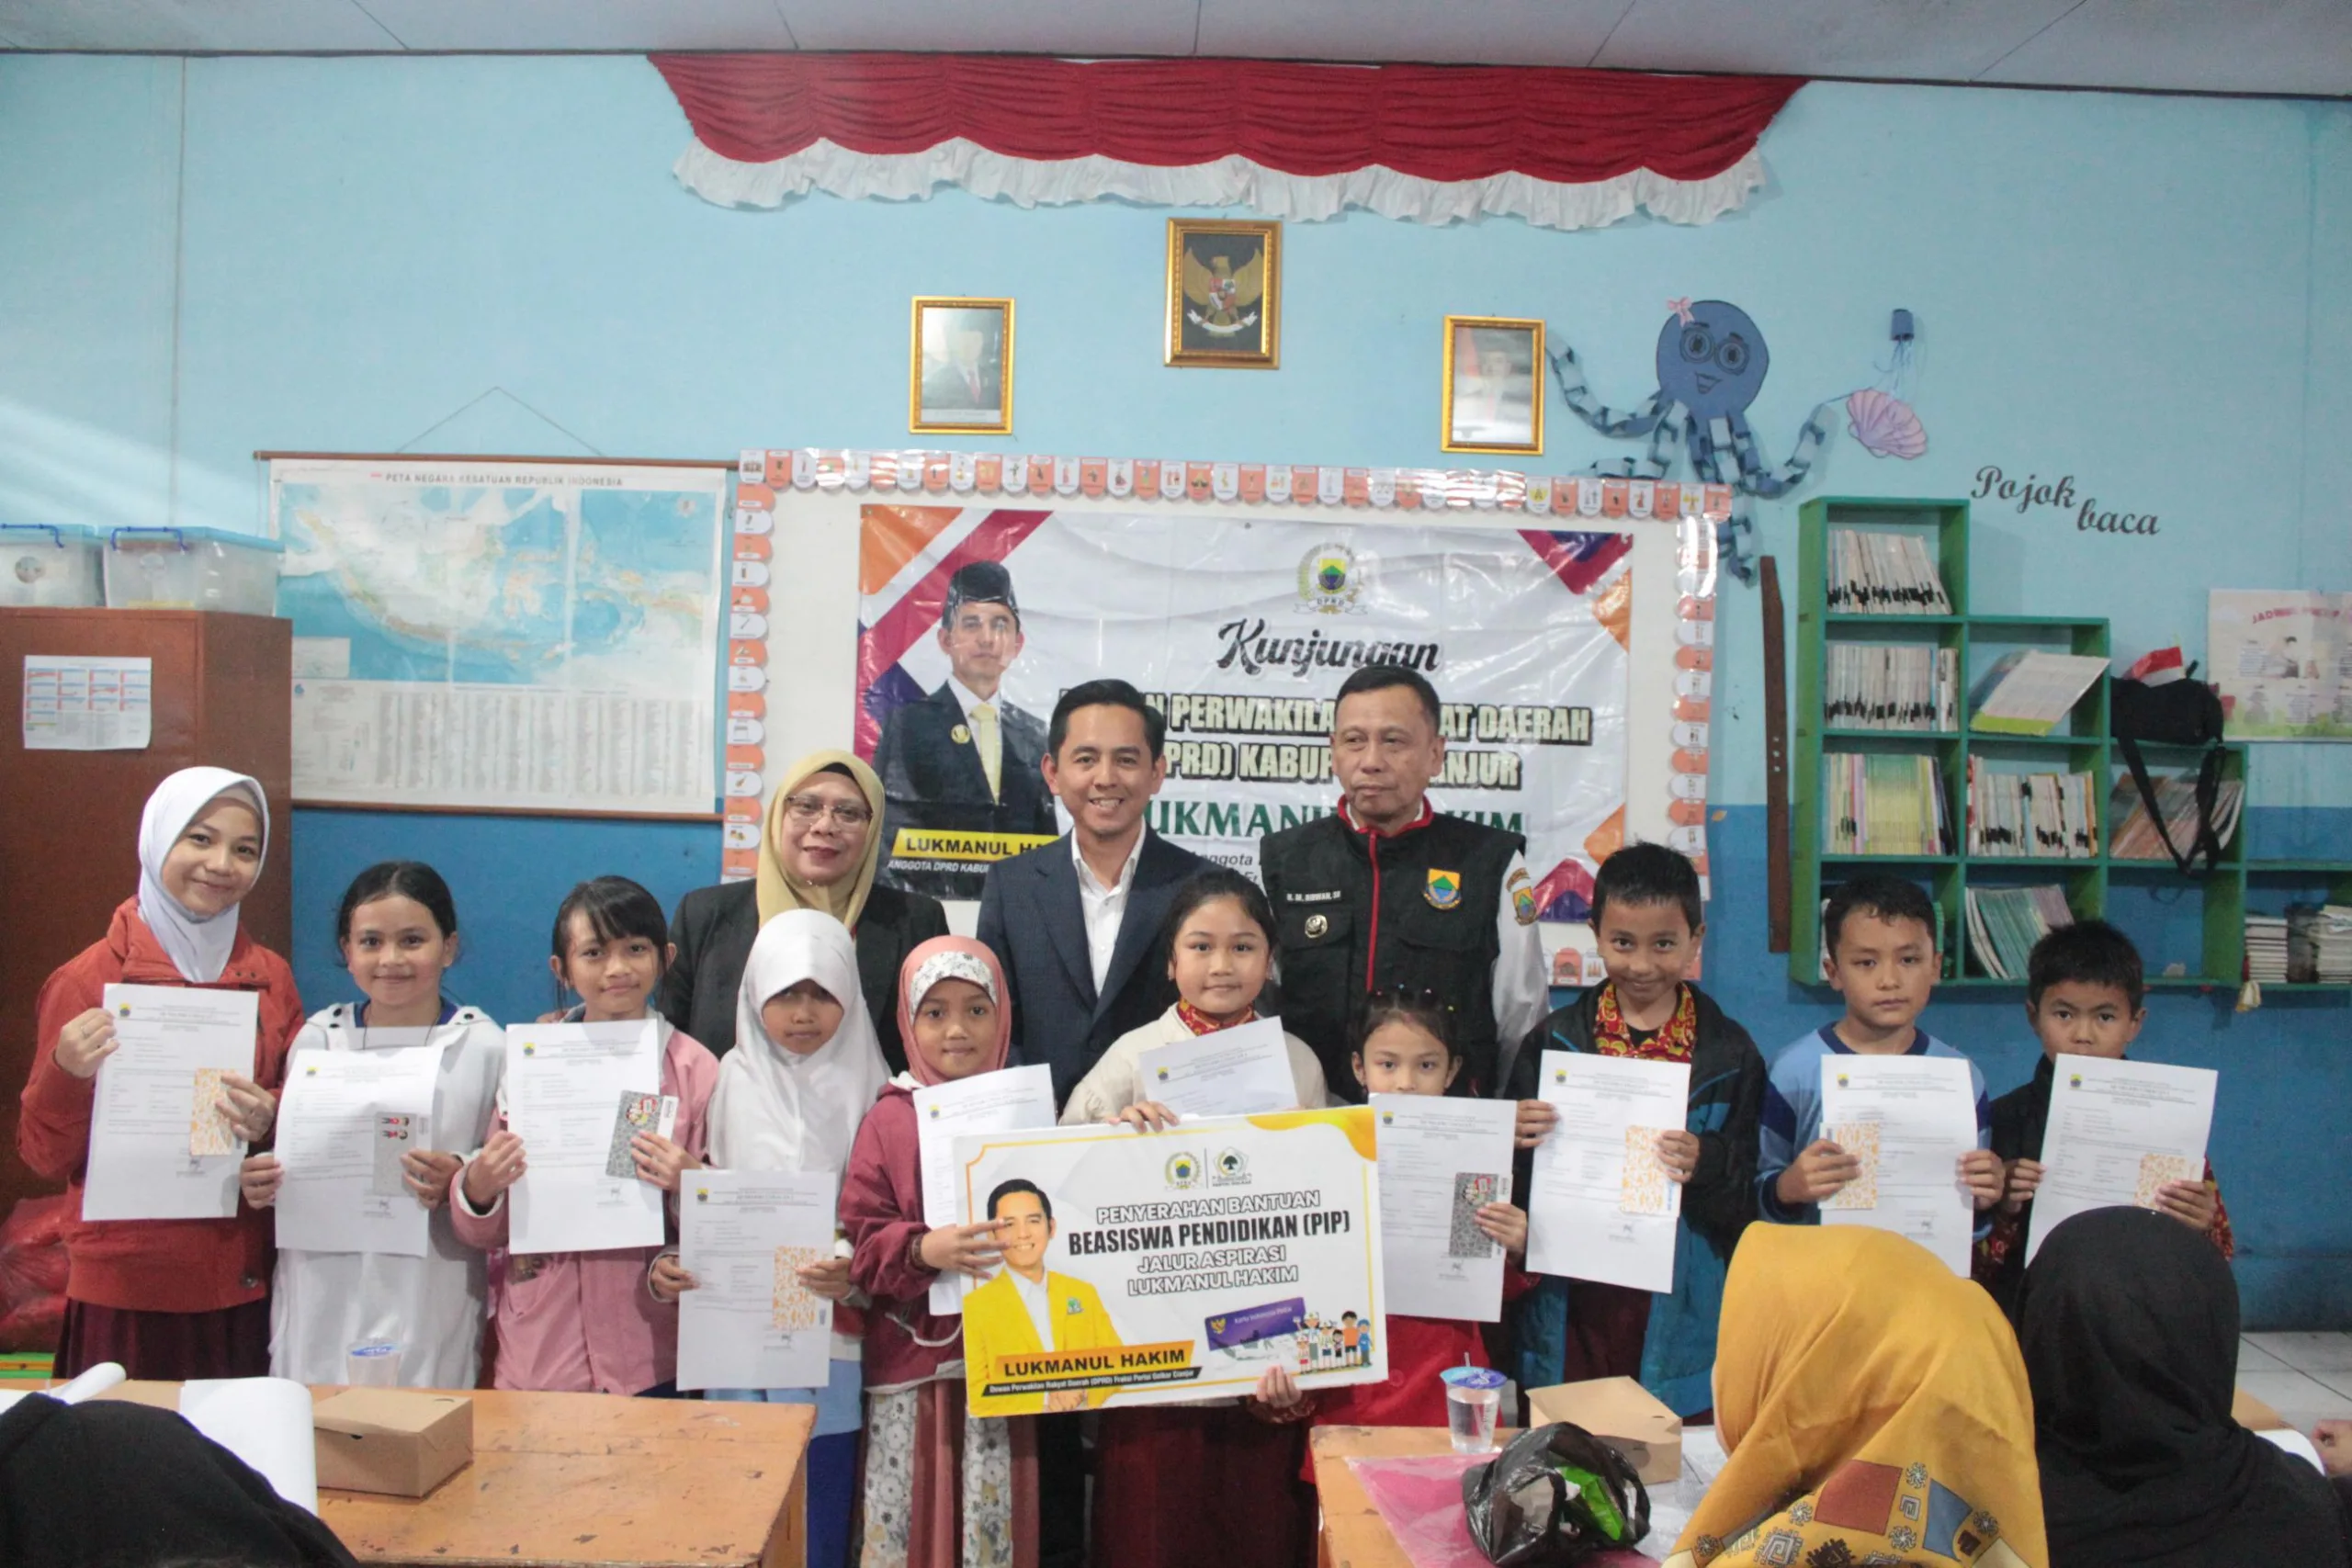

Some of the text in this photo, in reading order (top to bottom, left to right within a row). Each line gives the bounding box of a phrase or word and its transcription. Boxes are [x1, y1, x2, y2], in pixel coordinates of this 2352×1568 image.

[385, 473, 623, 487] PETA NEGARA KESATUAN REPUBLIK INDONESIA
[1971, 465, 2076, 514] Pojok
[2077, 498, 2161, 536] baca
[1216, 617, 1441, 677] Kunjungan
[1170, 694, 1335, 739] PERWAKILA
[1477, 704, 1592, 746] DAERAH
[1164, 740, 1521, 791] PRD) KABUP ANJUR
[906, 837, 1013, 856] LUKMANUL
[888, 859, 932, 872] ANGGOTA
[933, 862, 958, 873] DPRD
[1097, 1190, 1320, 1224] PENYERAHAN BANTUAN
[1069, 1210, 1351, 1256] BEASISWA PENDIDIKAN (PIP)
[1137, 1245, 1286, 1273] JALUR ASPIRASI
[1127, 1265, 1298, 1296] LUKMANUL HAKIM
[1004, 1349, 1185, 1377] LUKMANUL HAKIM
